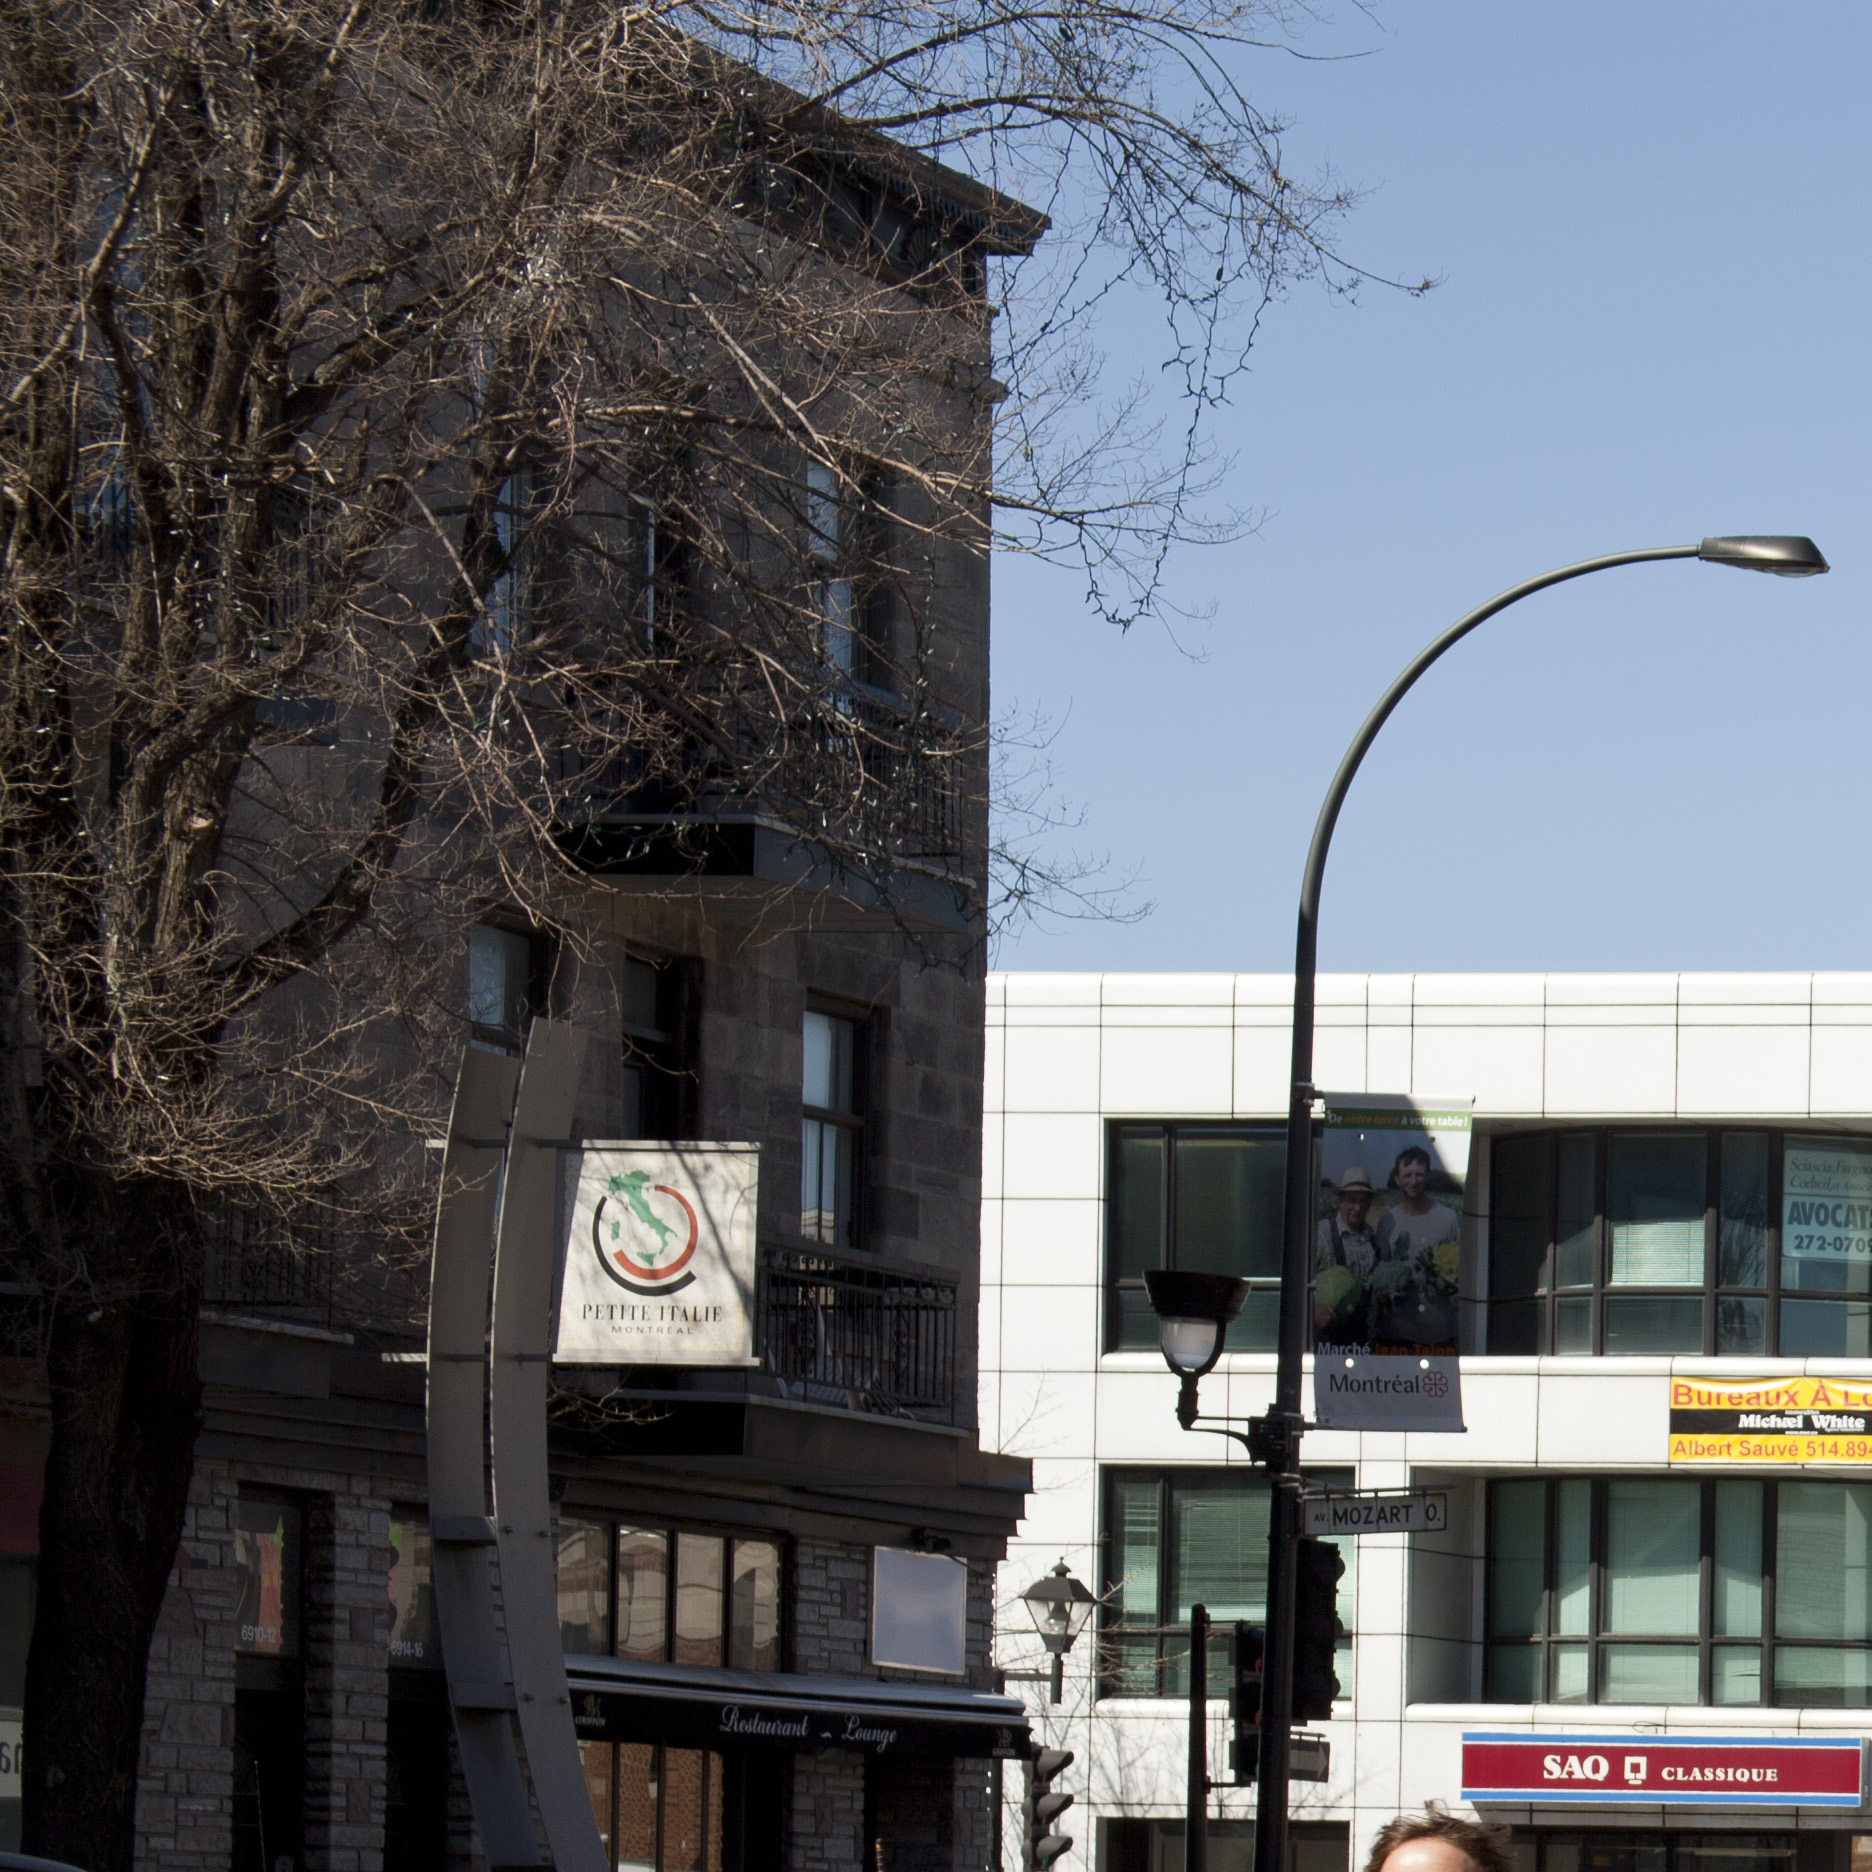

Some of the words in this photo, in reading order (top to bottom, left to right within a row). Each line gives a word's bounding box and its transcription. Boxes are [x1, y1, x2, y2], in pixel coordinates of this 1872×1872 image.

[1329, 1113, 1343, 1124] De
[1344, 1114, 1373, 1124] notre
[1374, 1115, 1399, 1125] terre
[1401, 1114, 1407, 1125] à
[1410, 1116, 1436, 1126] votre
[1437, 1116, 1468, 1127] table!
[583, 1303, 651, 1321] PETITE
[660, 1304, 722, 1323] ITALIE
[611, 1325, 693, 1335] MONTRÉAL
[1317, 1342, 1371, 1356] Marché
[1374, 1343, 1456, 1356] Jean-Talon
[1329, 1374, 1420, 1394] Montréal
[1673, 1384, 1799, 1408] Bureaux
[1810, 1379, 1832, 1407] À
[1810, 1414, 1866, 1429] White
[1673, 1440, 1732, 1457] Albert
[1739, 1440, 1799, 1457] Sauvé
[1332, 1504, 1413, 1527] MOZART
[1425, 1503, 1441, 1522] O.
[241, 1624, 276, 1643] 6910-12
[391, 1640, 423, 1658] 6914-16
[719, 1705, 809, 1738] Restaurant
[841, 1712, 898, 1753] Lounge
[1543, 1755, 1610, 1781] SAQ
[1661, 1767, 1778, 1782] CLASSIQUE
